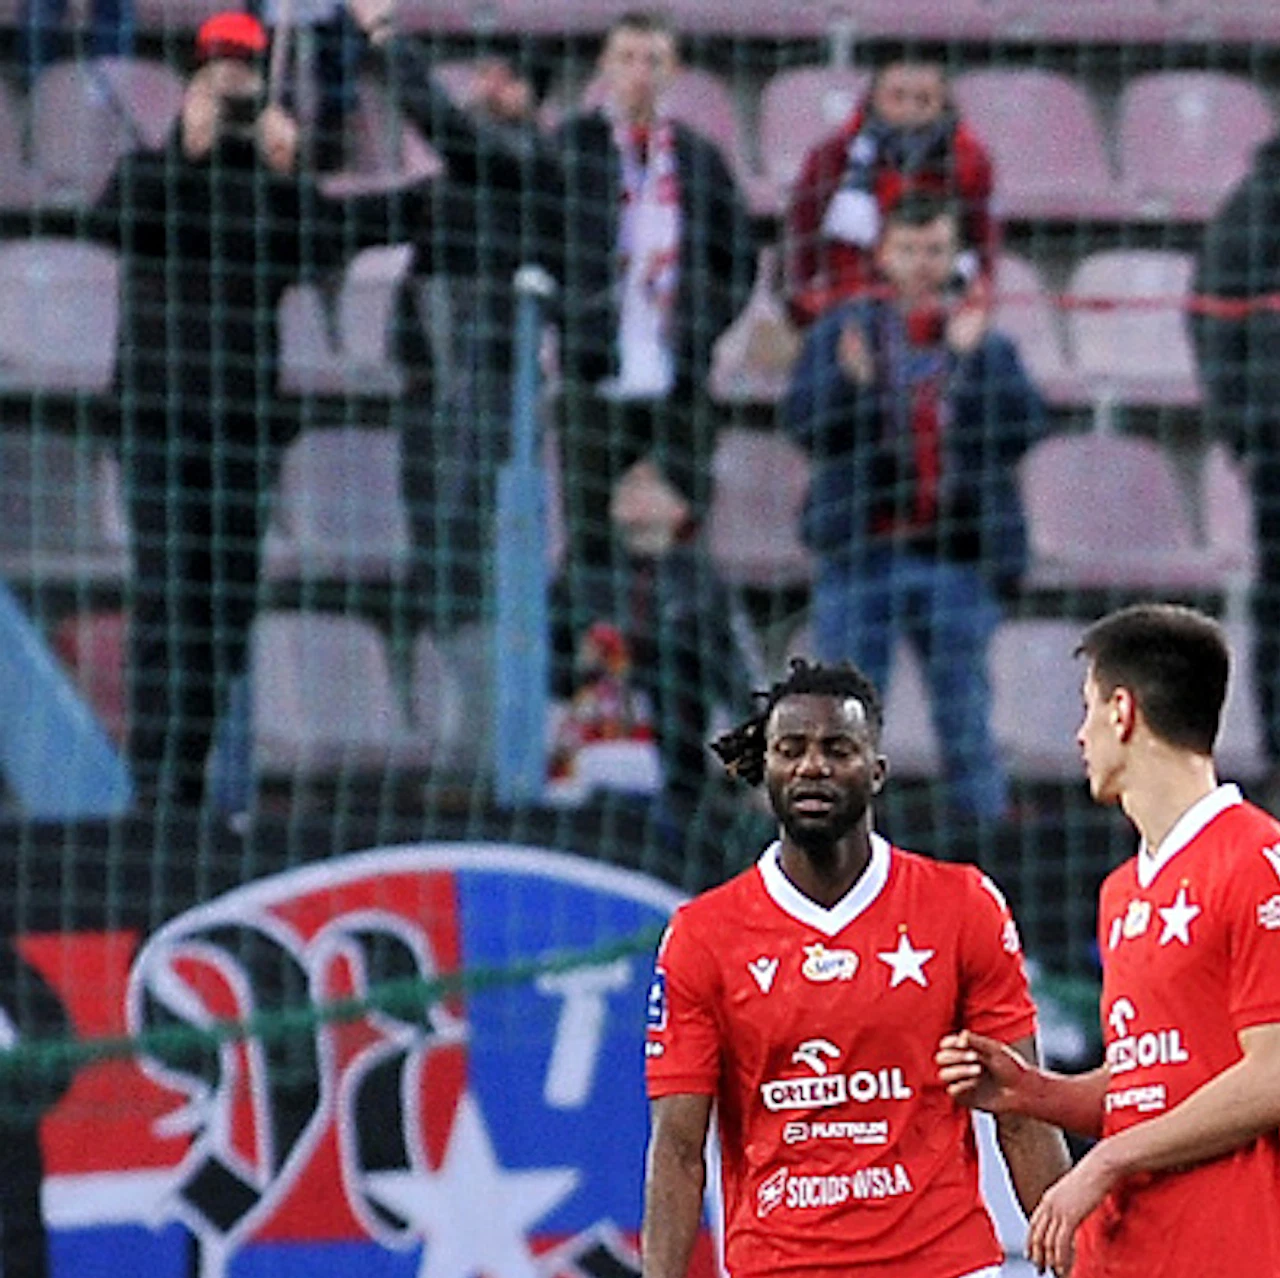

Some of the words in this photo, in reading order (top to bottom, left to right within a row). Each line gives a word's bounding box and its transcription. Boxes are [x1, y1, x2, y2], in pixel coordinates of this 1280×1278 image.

[1138, 1029, 1189, 1067] OIL
[767, 1078, 843, 1108] ORLEN
[849, 1068, 913, 1102] OIL
